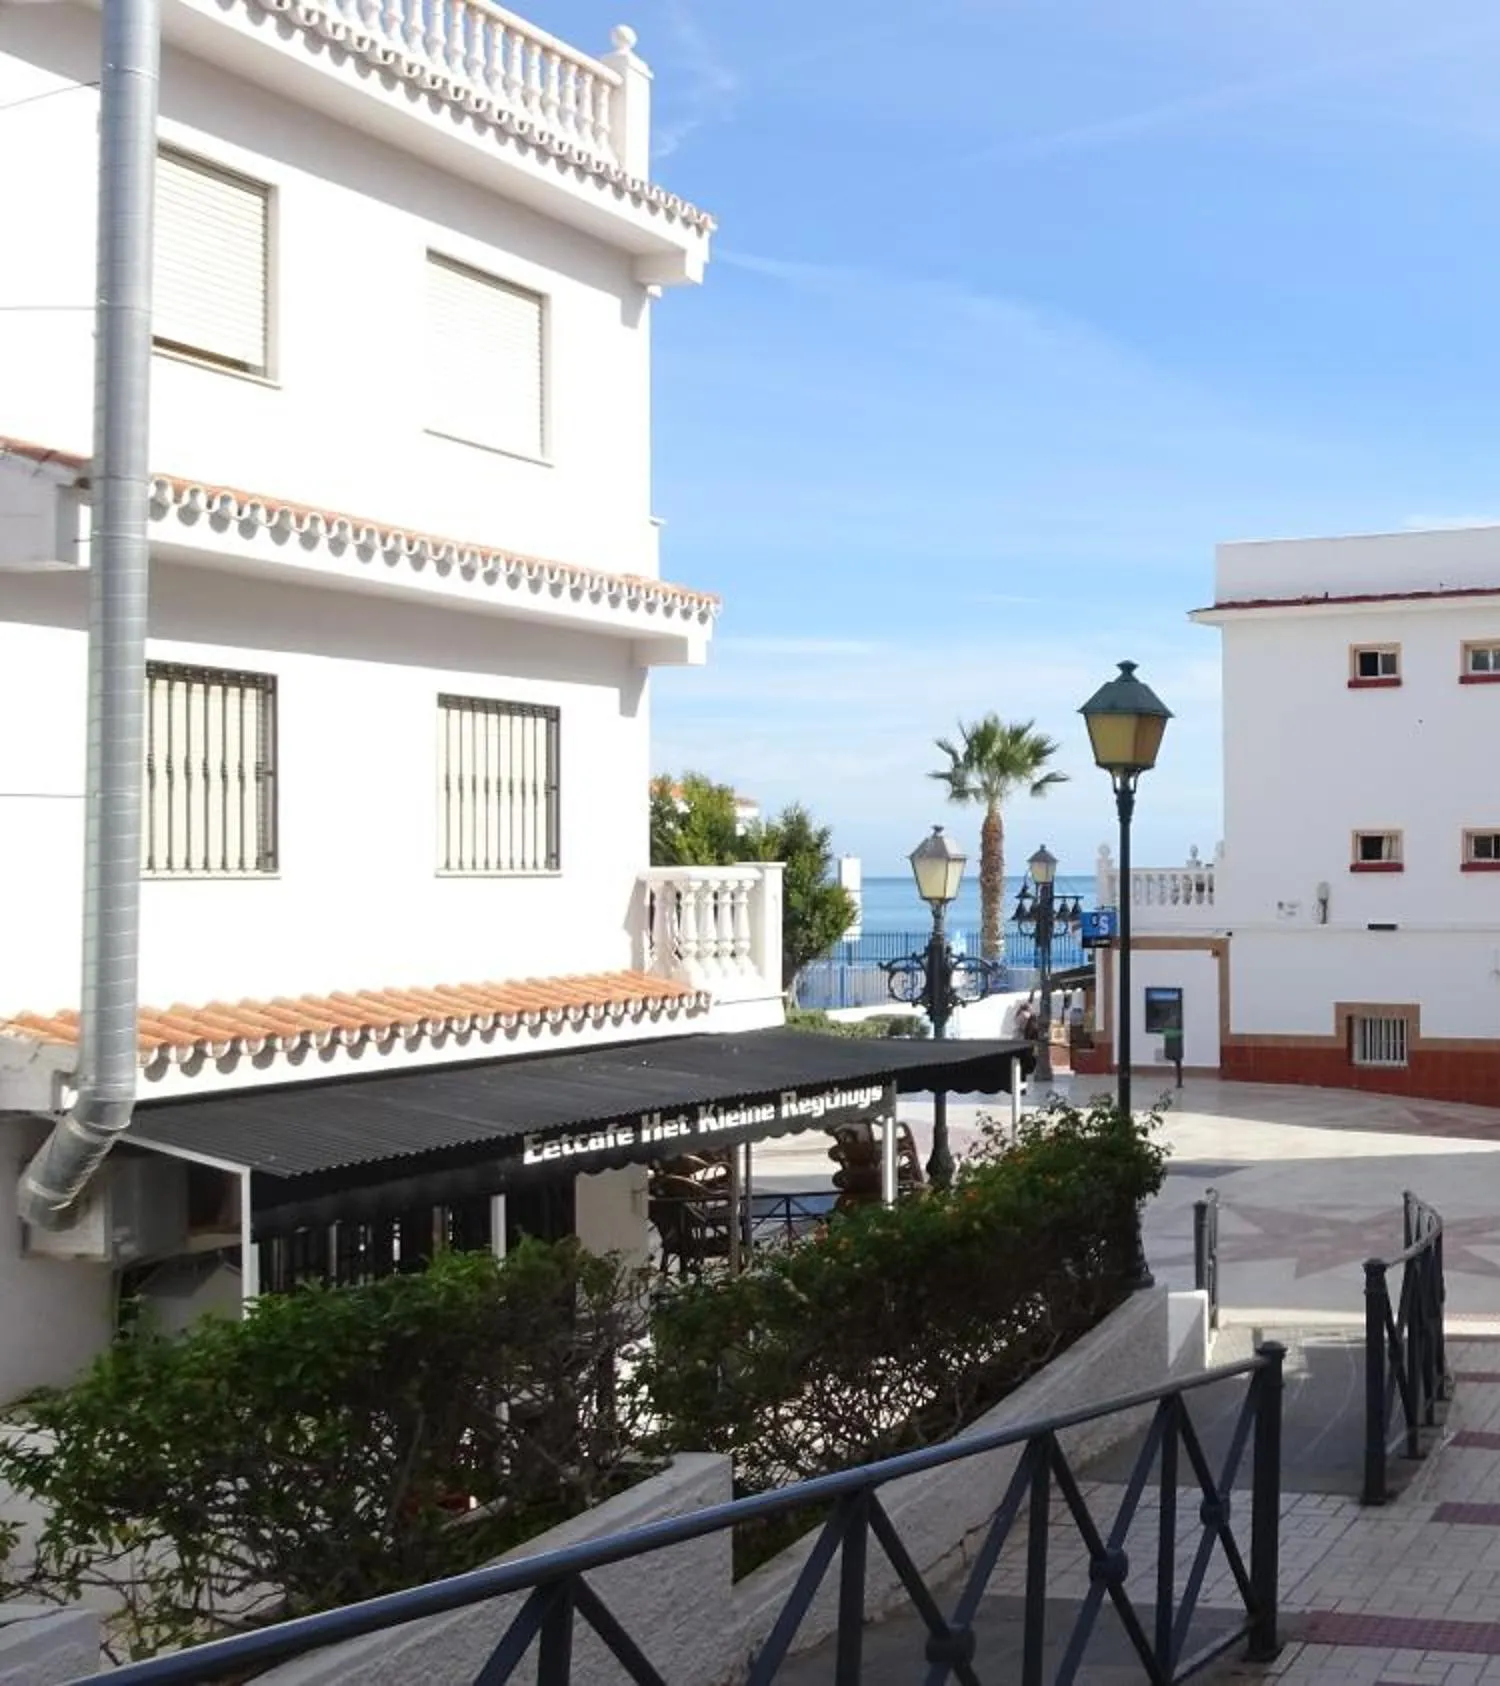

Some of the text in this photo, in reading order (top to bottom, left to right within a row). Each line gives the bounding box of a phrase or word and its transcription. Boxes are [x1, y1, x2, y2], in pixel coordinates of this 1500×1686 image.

[523, 1122, 635, 1165] Eetcafe
[641, 1111, 691, 1143] Het
[698, 1103, 776, 1133] Kleine
